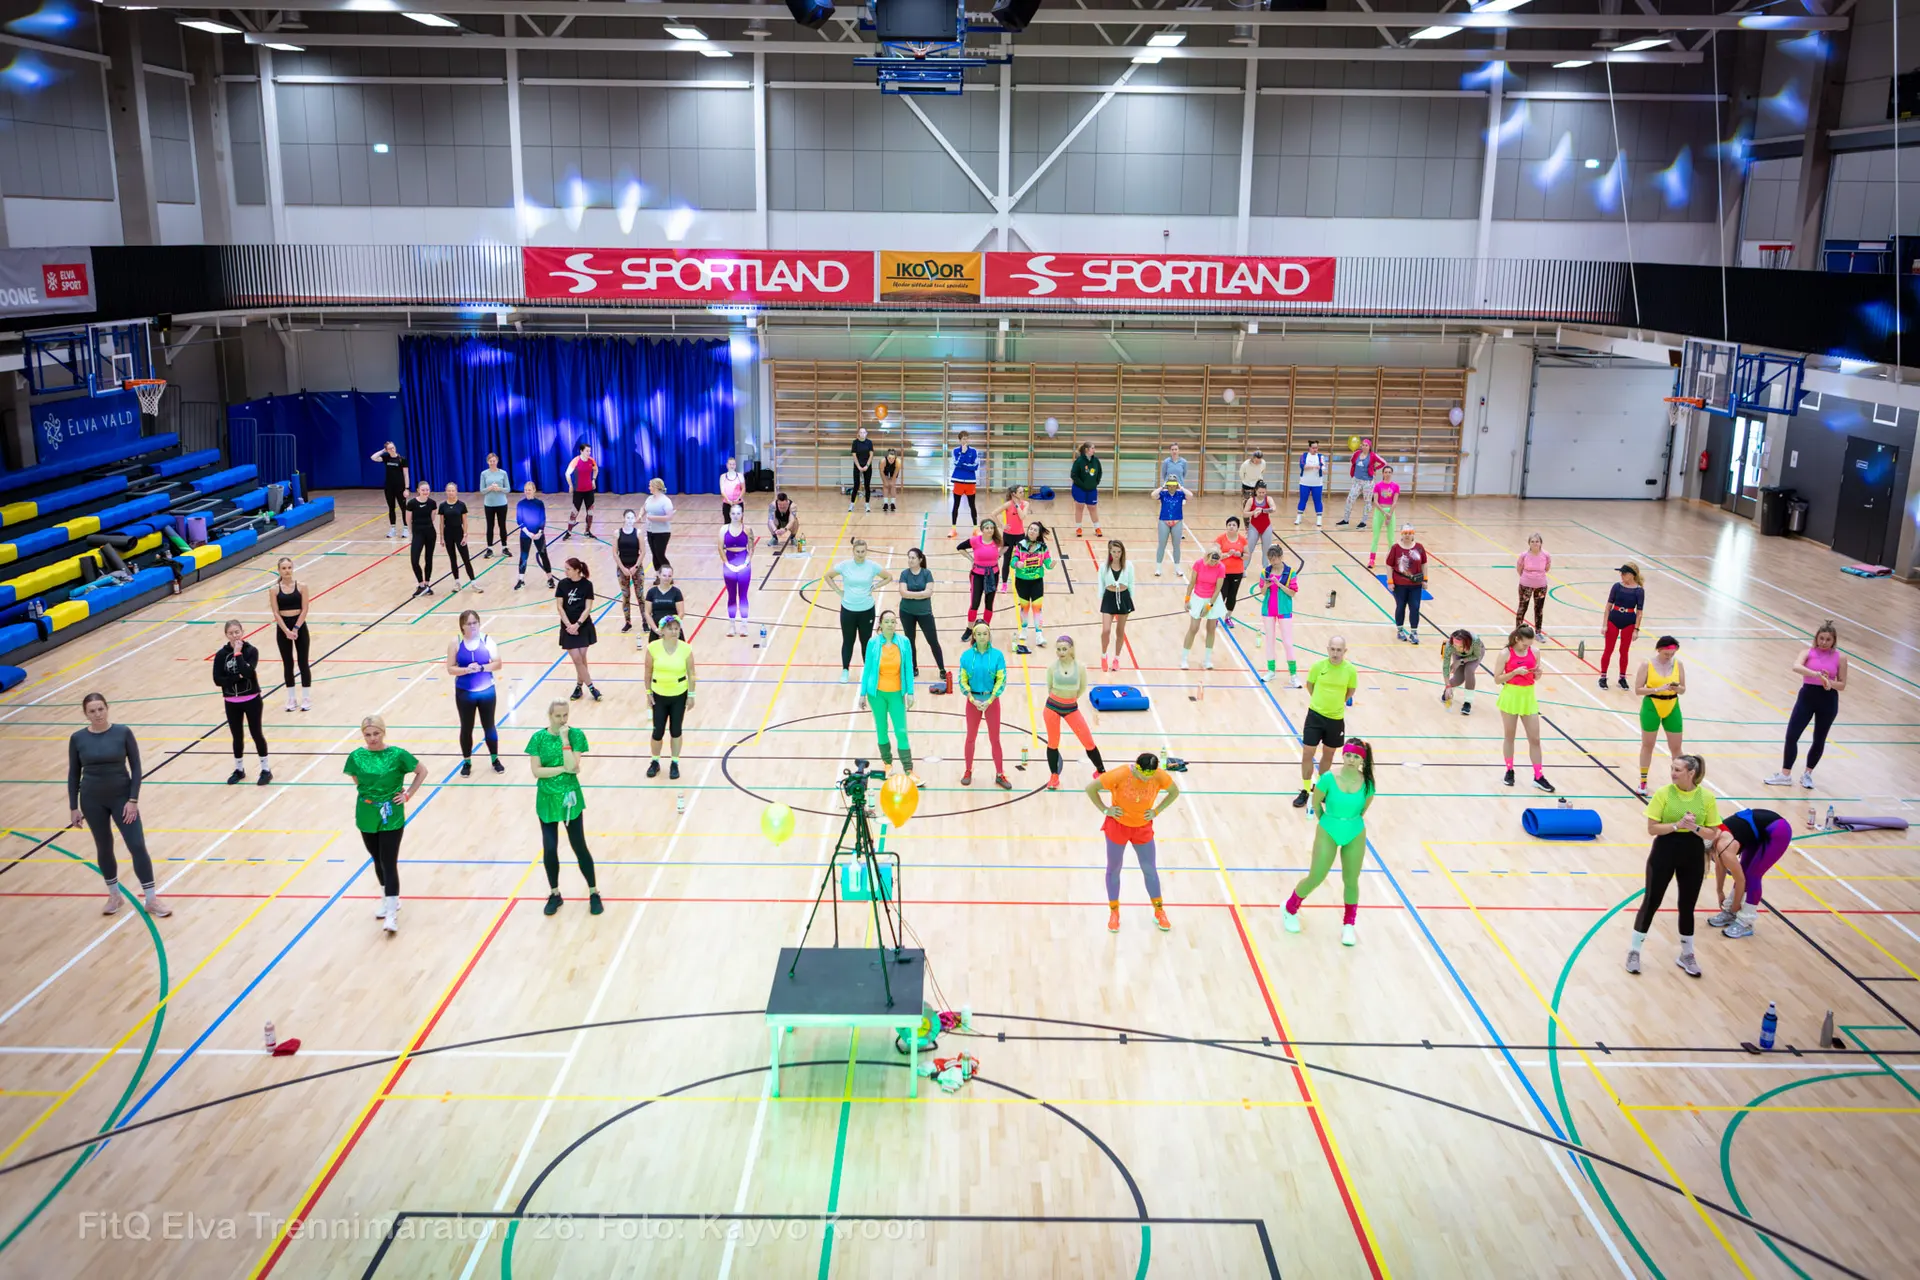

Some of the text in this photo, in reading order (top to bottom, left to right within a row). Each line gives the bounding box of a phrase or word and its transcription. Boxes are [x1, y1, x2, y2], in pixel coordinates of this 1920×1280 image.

[60, 270, 76, 280] ELVA
[621, 257, 850, 293] SPORTLAND
[896, 259, 964, 278] IKODOR
[1081, 259, 1311, 295] SPORTLAND
[62, 281, 82, 291] SPORT
[67, 411, 133, 436] ELVA VALD
